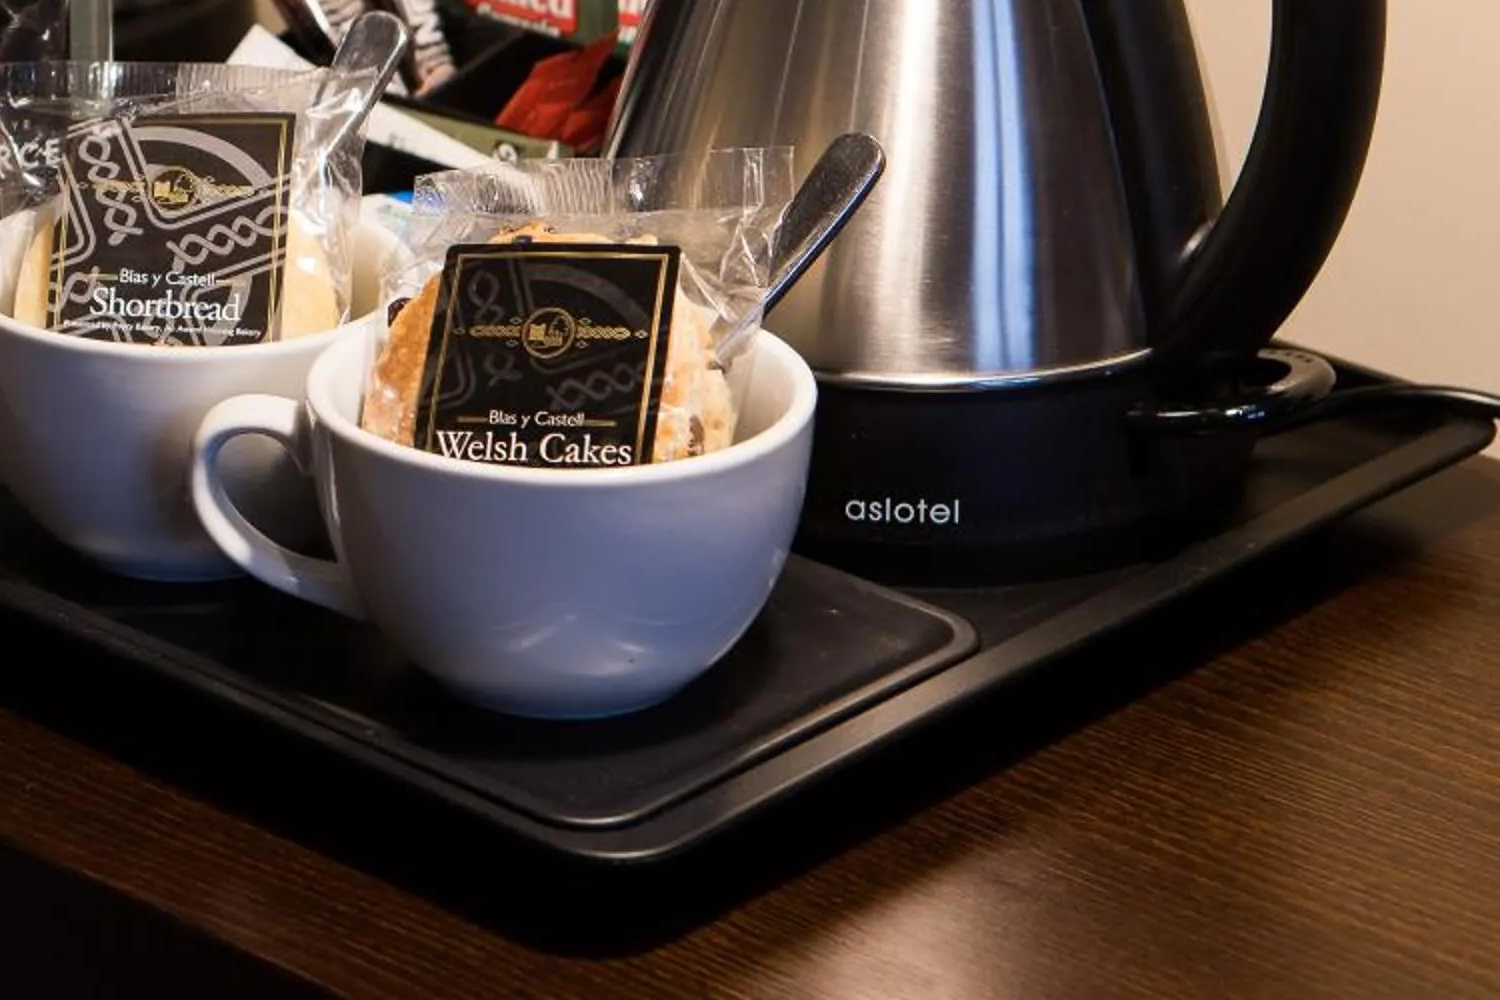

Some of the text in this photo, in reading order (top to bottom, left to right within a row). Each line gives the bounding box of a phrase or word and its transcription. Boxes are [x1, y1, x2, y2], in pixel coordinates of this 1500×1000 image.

[119, 267, 216, 288] Blas y Castell
[89, 286, 241, 321] Shortbread
[488, 409, 585, 429] Blas y Castell
[436, 430, 632, 465] Welsh Cakes
[844, 496, 960, 525] aslotel
